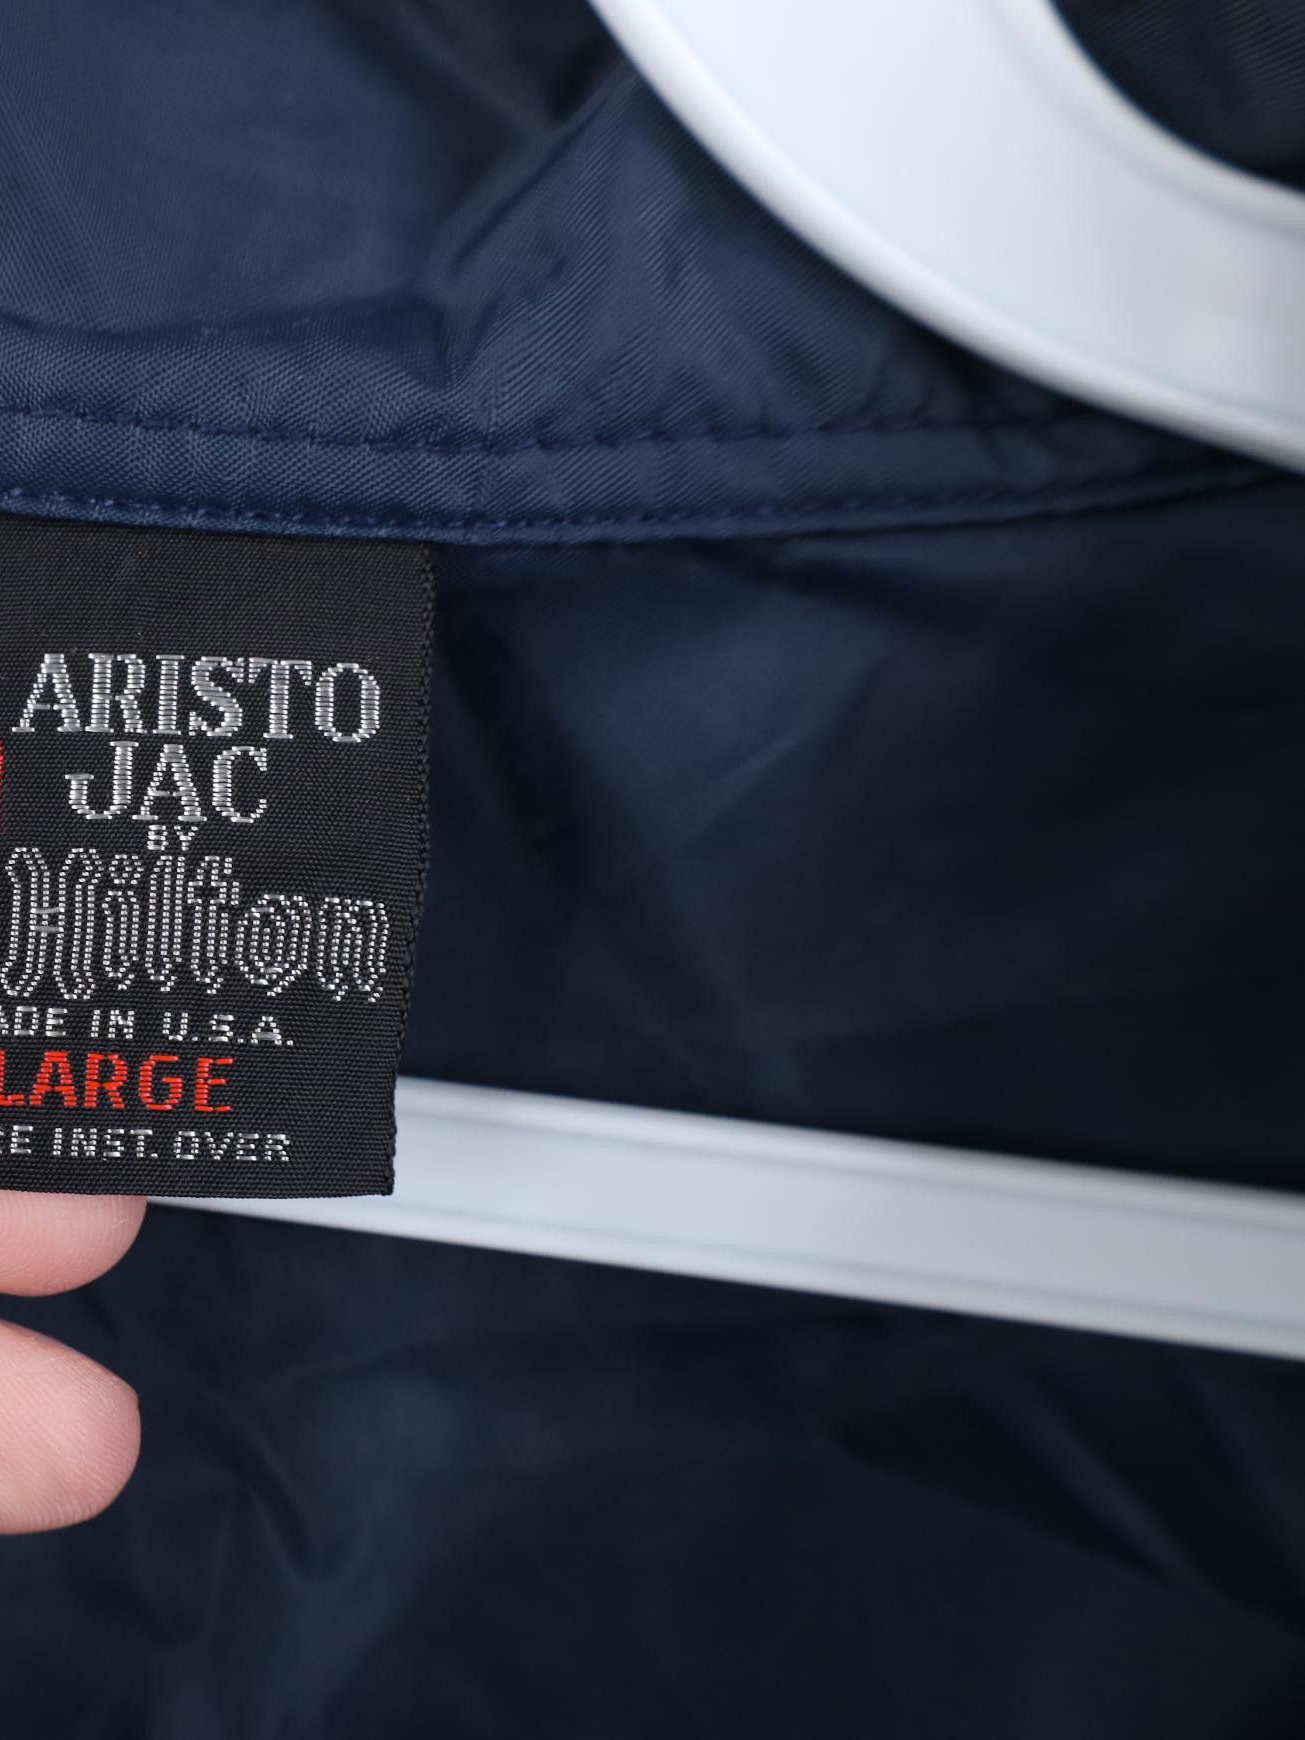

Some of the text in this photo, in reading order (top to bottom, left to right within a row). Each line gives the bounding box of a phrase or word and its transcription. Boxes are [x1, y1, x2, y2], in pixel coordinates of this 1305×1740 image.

[12, 653, 380, 742] ARISTO
[65, 741, 267, 823] JAC
[147, 825, 198, 851] BY
[91, 1010, 134, 1039] IN
[162, 1012, 293, 1045] U.S.A.
[53, 1128, 158, 1158] INST.
[174, 1131, 290, 1161] OVER
